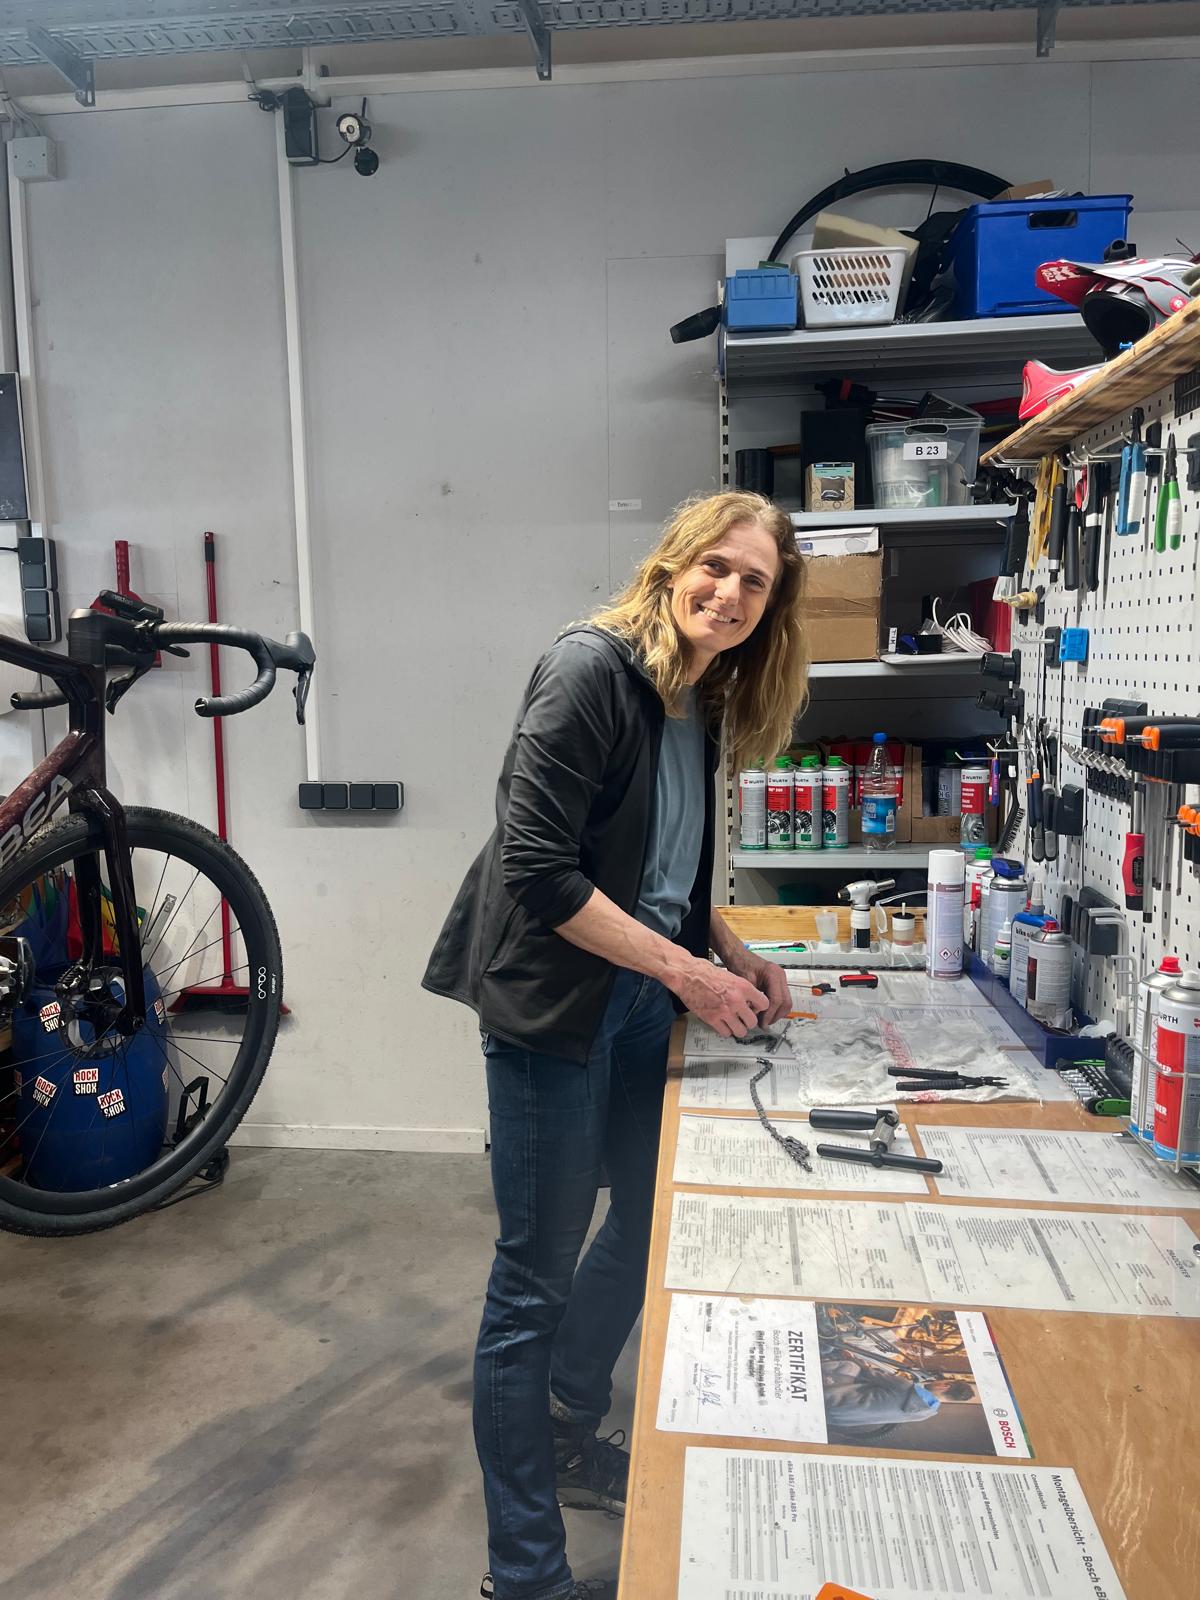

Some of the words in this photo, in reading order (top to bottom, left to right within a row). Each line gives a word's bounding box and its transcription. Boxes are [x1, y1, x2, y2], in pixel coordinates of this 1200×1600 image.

[915, 446, 924, 456] B
[926, 446, 940, 455] 23
[40, 1003, 60, 1019] ROCK
[75, 1069, 97, 1081] ROCK
[36, 1078, 57, 1096] ROCK
[75, 1083, 97, 1094] SHOX
[100, 1090, 122, 1107] ROCK
[103, 1101, 126, 1118] SHOX
[787, 1330, 808, 1402] ZERTIFIKAT
[998, 1420, 1017, 1449] BOSCH
[1030, 1473, 1048, 1510] ConnectModule
[1050, 1474, 1086, 1546] Montageübersicht
[1082, 1555, 1101, 1583] Bosch
